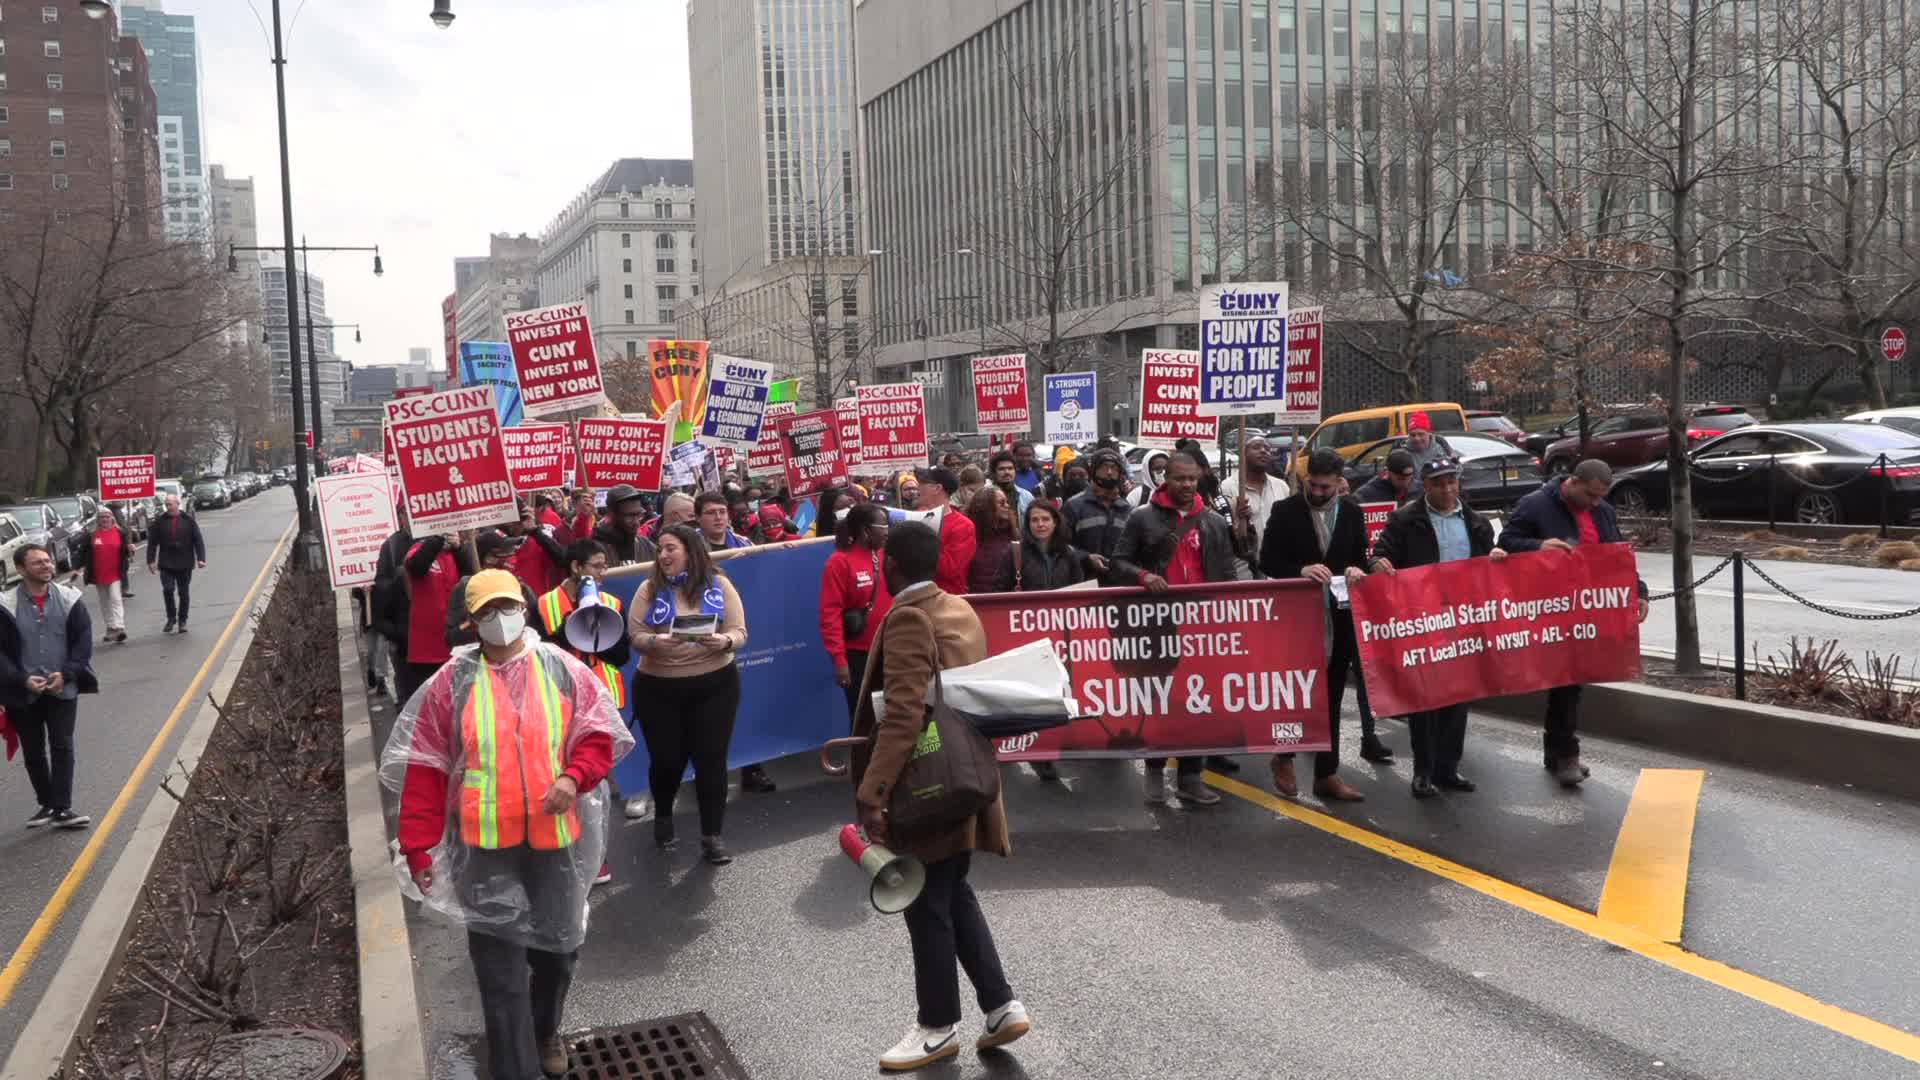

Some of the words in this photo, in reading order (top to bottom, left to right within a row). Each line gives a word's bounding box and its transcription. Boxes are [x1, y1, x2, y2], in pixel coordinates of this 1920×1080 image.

[1220, 294, 1280, 310] CUNY
[507, 304, 584, 328] PSC-CUNY
[514, 324, 561, 342] INVEST
[566, 320, 582, 333] IN
[1208, 320, 1258, 344] CUNY
[1262, 320, 1280, 343] IS
[1307, 328, 1317, 339] IN
[528, 340, 576, 362] CUNY
[1884, 338, 1904, 350] STOP
[654, 348, 699, 361] FREE
[1146, 352, 1199, 364] PSC-CU
[1207, 348, 1244, 372] FOR
[1248, 347, 1280, 370] THE
[524, 362, 569, 380] INVEST
[574, 359, 588, 372] IN
[973, 357, 1023, 370] PSC-CUNY
[654, 364, 700, 380] CUNY
[726, 364, 767, 380] CUNY
[976, 371, 1024, 384] STUDENTS,
[1150, 366, 1194, 378] INVEST
[1306, 371, 1316, 383] IN
[522, 384, 555, 401] NEW
[558, 375, 600, 394] YORK
[982, 384, 1019, 396] FACULTY
[1055, 378, 1090, 388] STRONGER
[1210, 374, 1275, 400] PEOPLE
[724, 383, 745, 398] CUNY
[746, 385, 755, 399] IS
[858, 385, 920, 398] PSC-CUNY
[388, 388, 489, 420] PSC-CUNY
[709, 395, 736, 410] ABOUT
[737, 398, 763, 414] RACIAL
[997, 398, 1004, 408] &
[1294, 392, 1318, 406] YORK
[860, 401, 921, 416] STUDENTS,
[978, 410, 998, 422] STAFF
[1000, 408, 1026, 422] UNITED
[1149, 403, 1192, 415] INVEST
[709, 412, 716, 422] &
[717, 411, 758, 427] ECONOMIC
[868, 416, 916, 430] FACULTY
[396, 416, 497, 448] STUDENTS,
[584, 424, 614, 437] FUND
[716, 426, 747, 440] JUSTICE
[1060, 423, 1072, 431] FOR
[1143, 420, 1173, 434] NEW
[1176, 422, 1214, 436] YORK
[504, 433, 530, 444] FUND
[889, 430, 897, 442] &
[1048, 433, 1084, 441] STRONGER
[412, 438, 488, 468] FACULTY
[528, 443, 562, 455] PEOPLE'S
[580, 439, 600, 450] THE
[606, 441, 661, 453] PEOPLE'S
[864, 444, 890, 458] STAFF
[892, 442, 924, 455] UNITED
[508, 456, 559, 469] UNIVERSITY
[584, 454, 655, 466] UNIVERSITY
[750, 456, 770, 466] NEW
[788, 455, 813, 469] FUND
[815, 450, 839, 464] SUNY
[448, 466, 464, 484] &
[520, 472, 548, 483] PSC-CUNY
[596, 472, 638, 481] PSC-CUNY
[800, 469, 807, 479] &
[809, 463, 832, 477] CUNY
[105, 476, 150, 486] UNIVERSITY
[410, 490, 451, 514] STAFF
[455, 480, 510, 506] UNITED
[340, 562, 366, 576] FULL
[1010, 604, 1120, 633] ECONOMIC
[1128, 598, 1279, 628] OPPORTUNITY.
[1361, 608, 1456, 641] Professional
[1458, 600, 1498, 625] Staff
[1501, 594, 1570, 621] Congress
[1580, 587, 1631, 610] CUNY
[1160, 632, 1249, 660] JUSTICE.
[1402, 648, 1426, 668] AFT
[1430, 643, 1457, 663] Local
[1458, 638, 1484, 656] 2334
[1496, 630, 1530, 651] NYSUT
[1541, 626, 1564, 644] AFL
[1573, 624, 1597, 640] CIO
[1084, 676, 1174, 718] SUNY
[1186, 674, 1212, 714] &
[1222, 670, 1317, 713] CUNY
[1274, 724, 1302, 738] PSC
